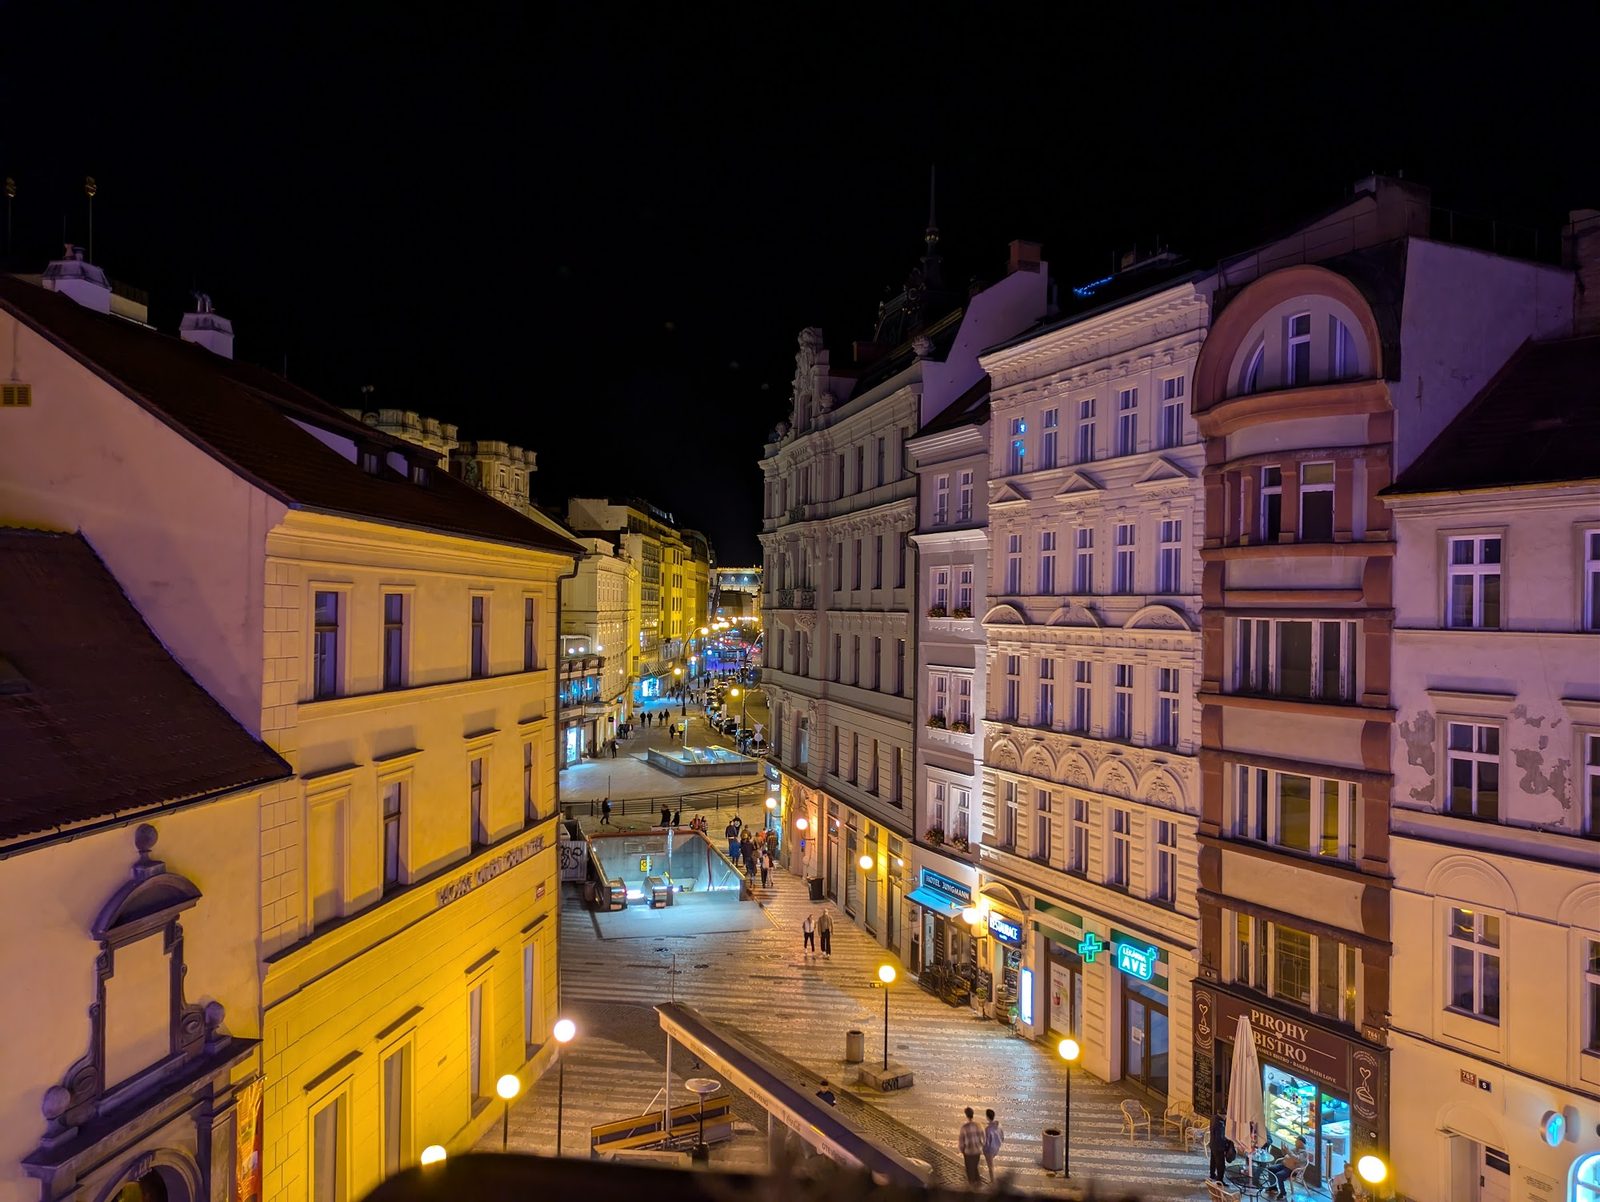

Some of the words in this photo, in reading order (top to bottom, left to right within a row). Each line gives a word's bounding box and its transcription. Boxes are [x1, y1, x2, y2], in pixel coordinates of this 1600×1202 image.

[926, 875, 941, 887] HOTEL
[942, 881, 970, 900] JUNGMANN
[1122, 956, 1147, 977] AVE
[1251, 1009, 1309, 1043] PIROHY
[1252, 1030, 1307, 1063] BISTRO
[1323, 1073, 1337, 1084] LOVE
